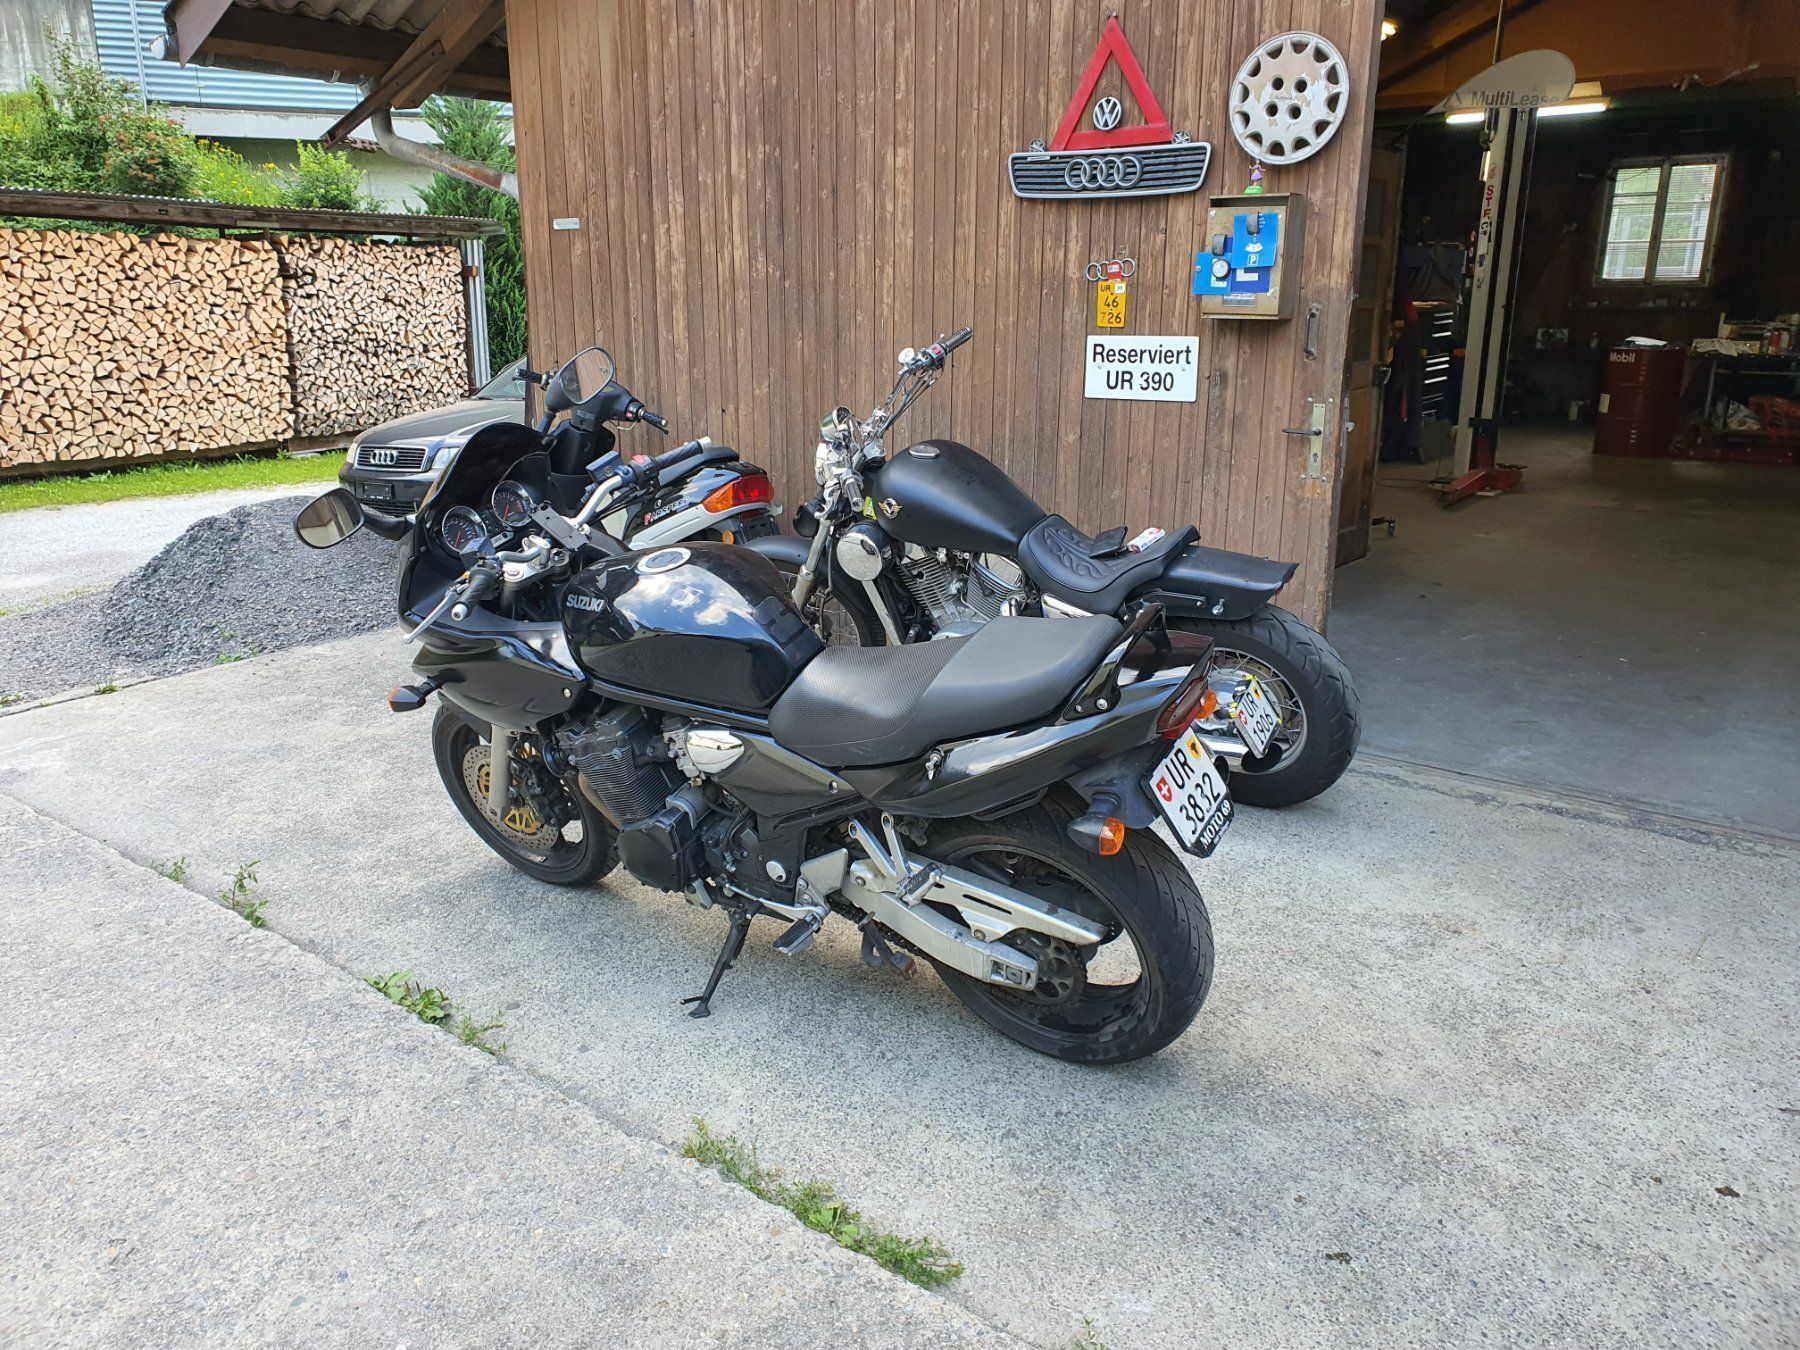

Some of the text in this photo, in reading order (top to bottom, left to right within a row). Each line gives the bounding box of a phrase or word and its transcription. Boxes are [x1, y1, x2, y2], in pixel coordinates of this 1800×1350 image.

[1100, 284, 1112, 292] UR
[1104, 295, 1119, 308] 46
[1092, 343, 1192, 365] Reserviert
[1609, 352, 1636, 363] Mobil
[1106, 370, 1174, 392] UR 390
[566, 594, 605, 612] SUZUKI
[1241, 692, 1259, 718] UR
[1252, 707, 1274, 746] 1906
[1164, 747, 1196, 790] UR
[1179, 771, 1221, 835] 3832
[1199, 811, 1224, 850] MOTO
[1221, 799, 1231, 816] 69
